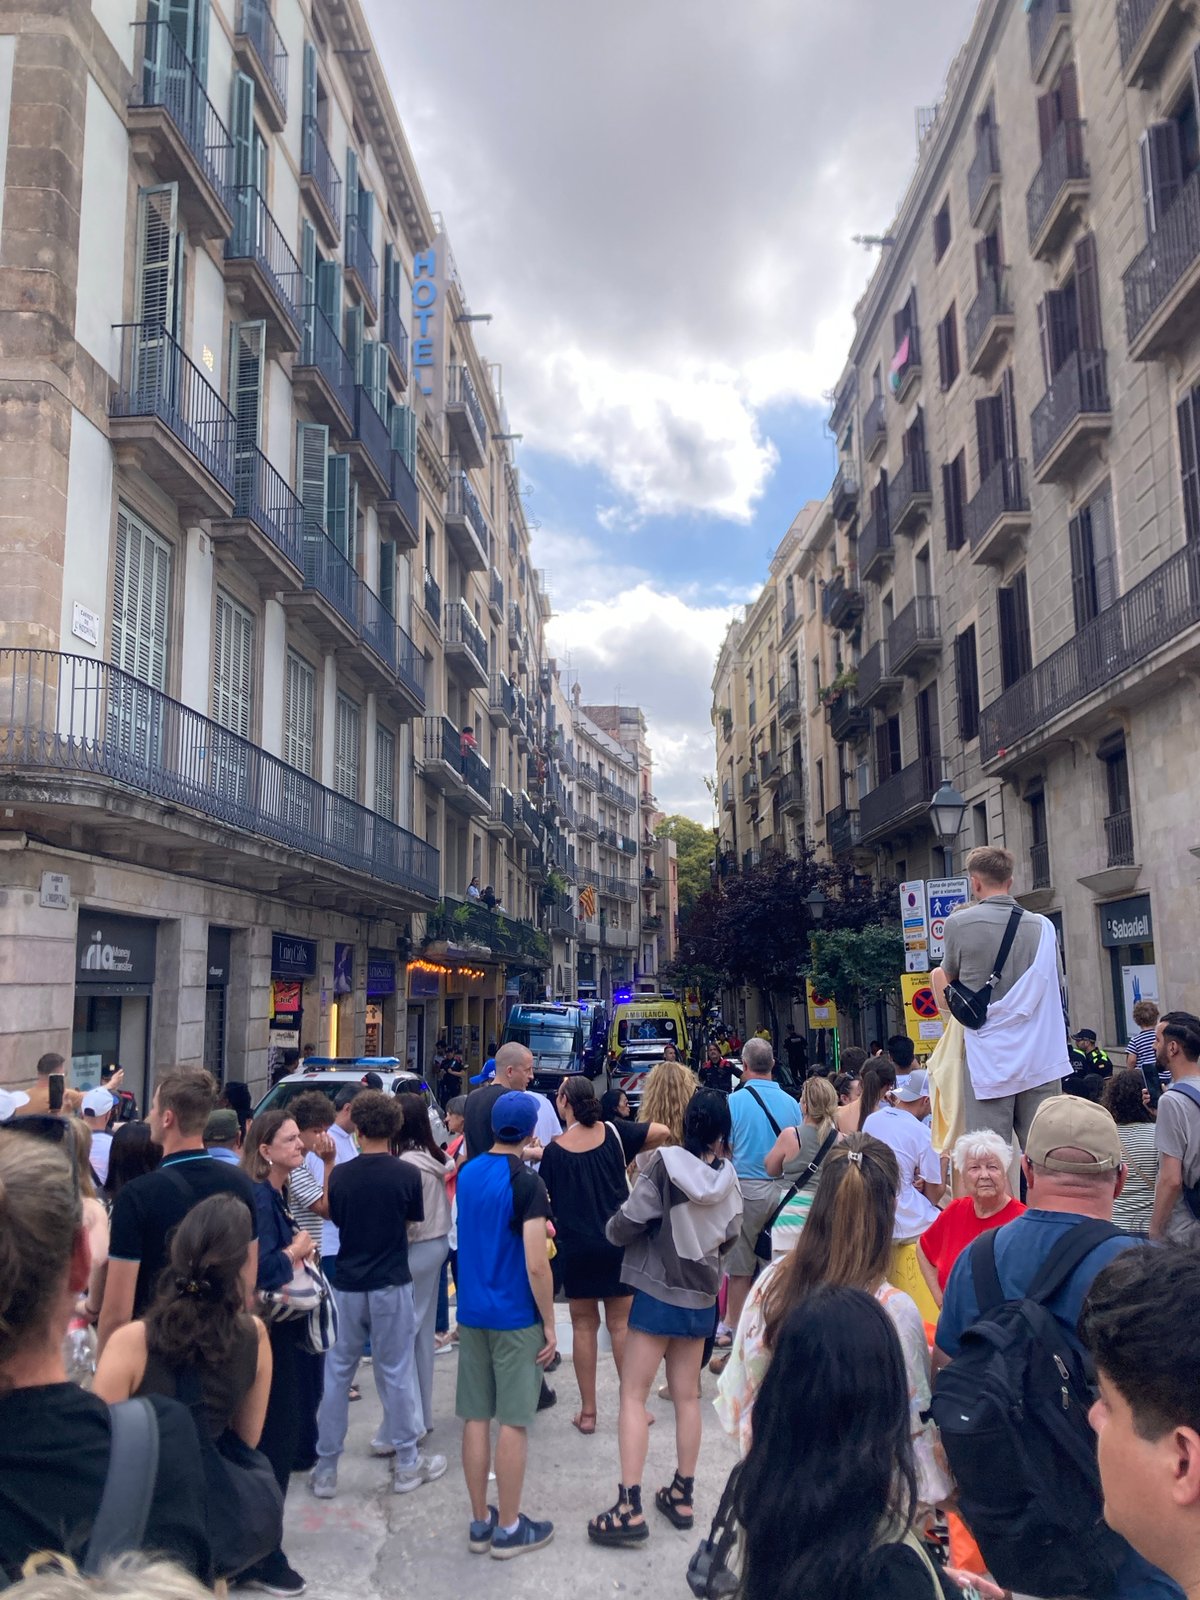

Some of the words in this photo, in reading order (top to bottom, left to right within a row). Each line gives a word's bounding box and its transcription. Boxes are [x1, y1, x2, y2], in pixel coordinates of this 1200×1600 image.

[412, 250, 437, 396] HOTEL
[947, 880, 965, 888] prioritat
[935, 926, 943, 934] 10
[1112, 915, 1149, 939] Sabadell
[83, 930, 114, 970] ria
[113, 945, 131, 960] Money
